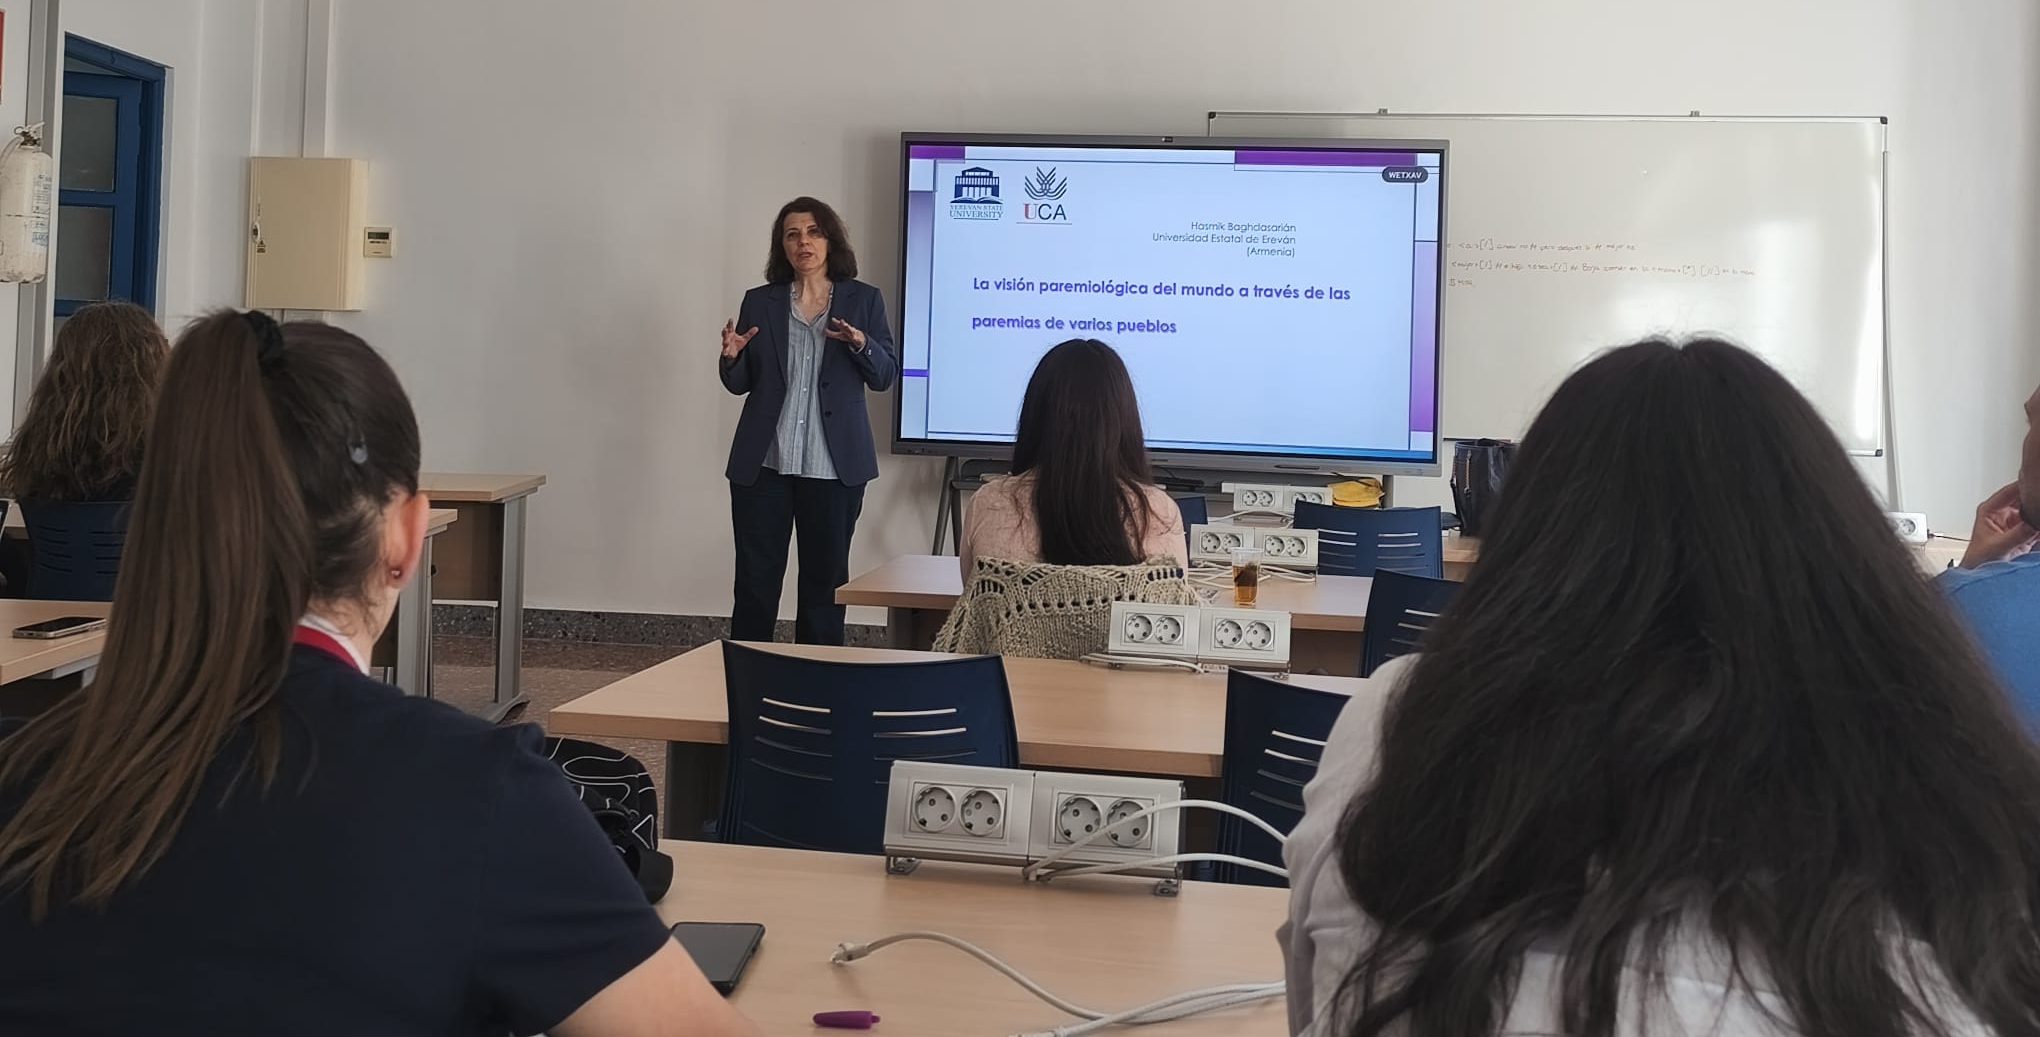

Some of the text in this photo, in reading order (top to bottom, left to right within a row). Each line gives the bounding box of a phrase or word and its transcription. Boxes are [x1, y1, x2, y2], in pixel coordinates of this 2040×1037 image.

[1388, 171, 1422, 179] WETXAV
[950, 210, 1003, 218] UNIVERSITY
[1023, 203, 1067, 220] UCA
[1191, 221, 1296, 233] Hasmik Baghdasarián
[1152, 232, 1296, 244] Universidad Estatal de Ereván
[1246, 246, 1296, 258] (Armenia)
[973, 277, 1351, 301] La visión paremiológica del mundo a través de las
[971, 315, 1178, 334] paremias de varios pueblos
